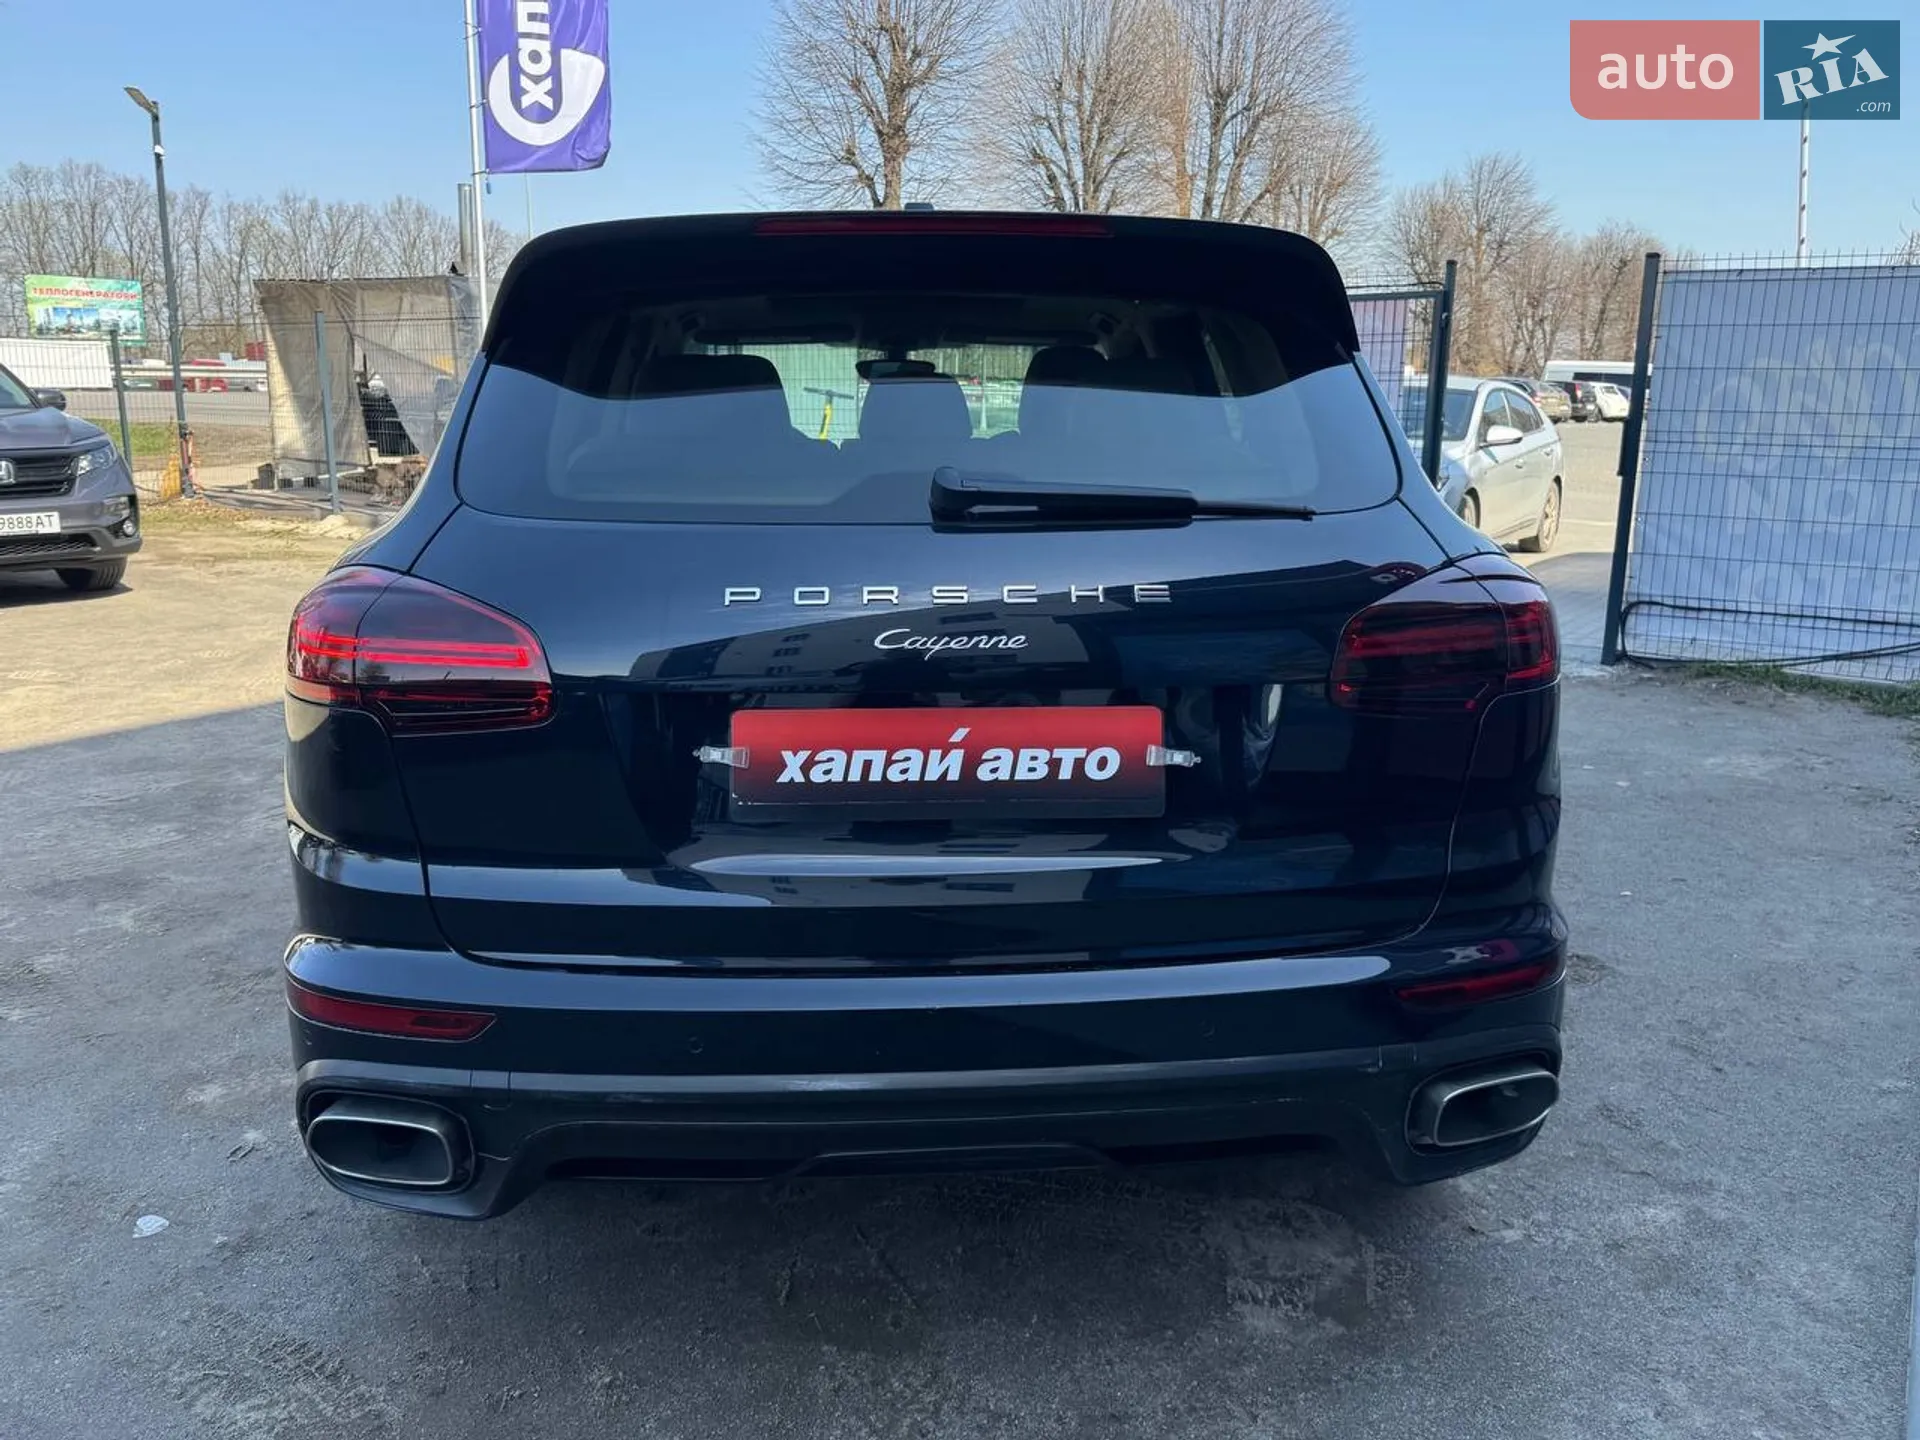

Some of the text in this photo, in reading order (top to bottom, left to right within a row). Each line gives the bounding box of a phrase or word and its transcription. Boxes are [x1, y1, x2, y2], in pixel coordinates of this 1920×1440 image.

[724, 584, 1172, 607] PORSCHE
[874, 628, 1028, 660] Cayenne
[776, 728, 1121, 784] хапай авто
